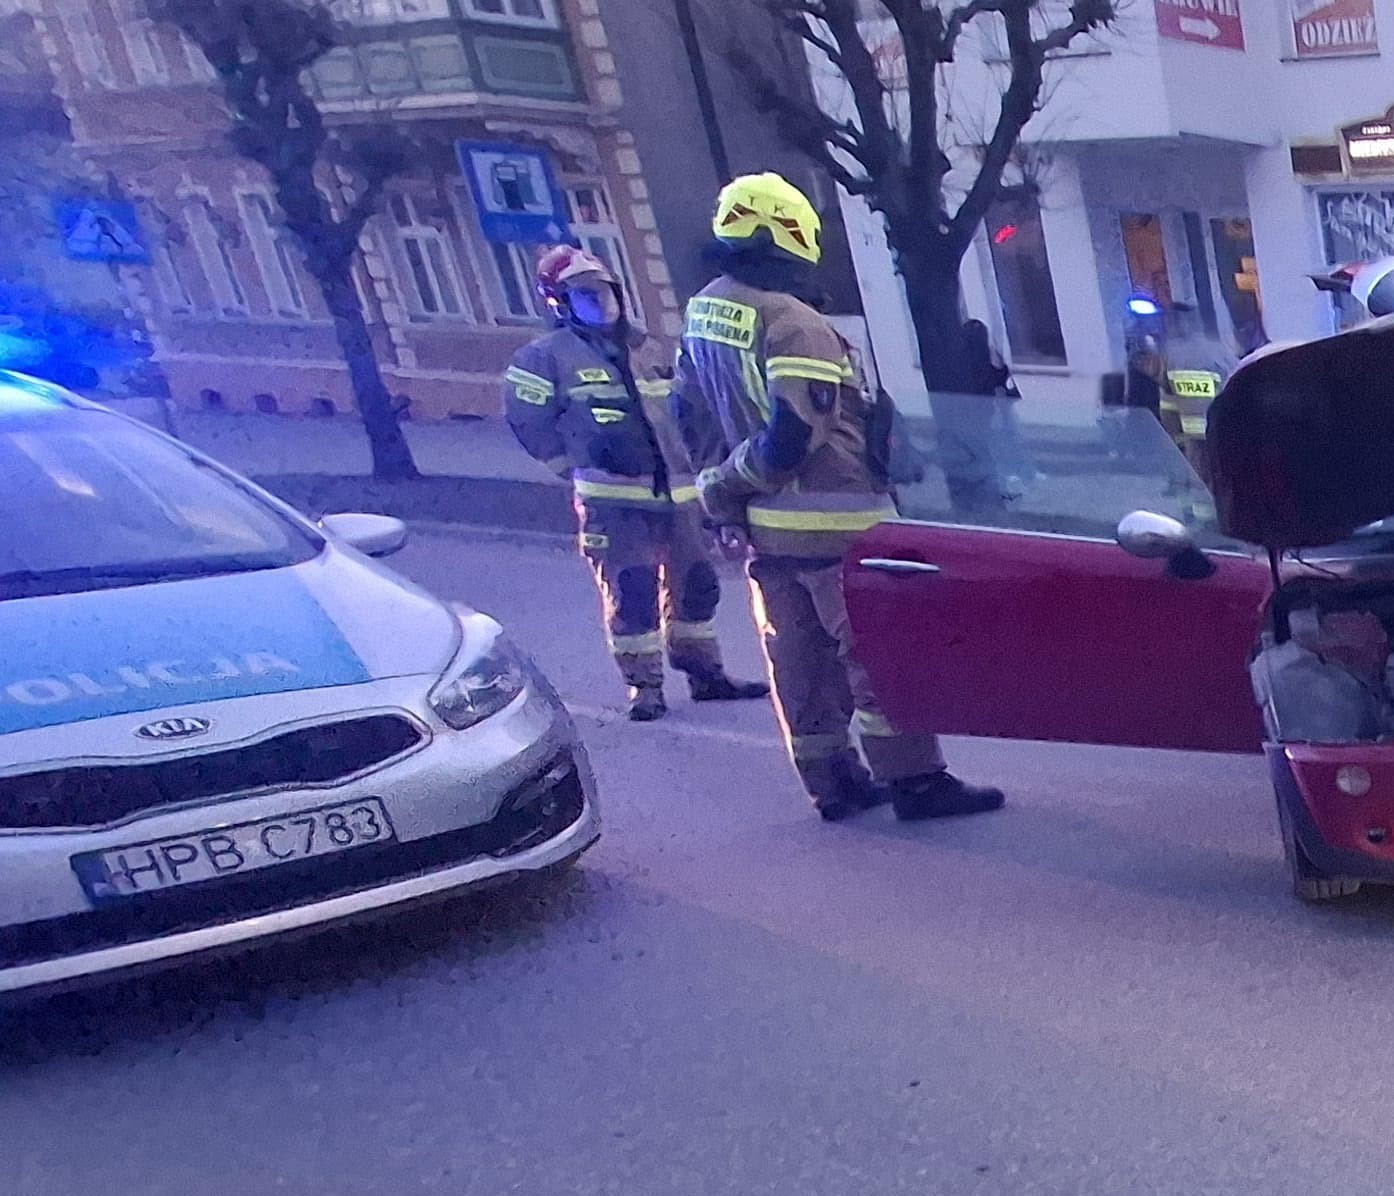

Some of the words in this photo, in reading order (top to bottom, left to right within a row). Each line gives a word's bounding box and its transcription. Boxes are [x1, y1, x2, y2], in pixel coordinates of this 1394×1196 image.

[4, 650, 301, 705] OLICJA
[147, 718, 204, 737] KIA
[117, 833, 246, 890] HPB
[261, 805, 382, 860] C783
